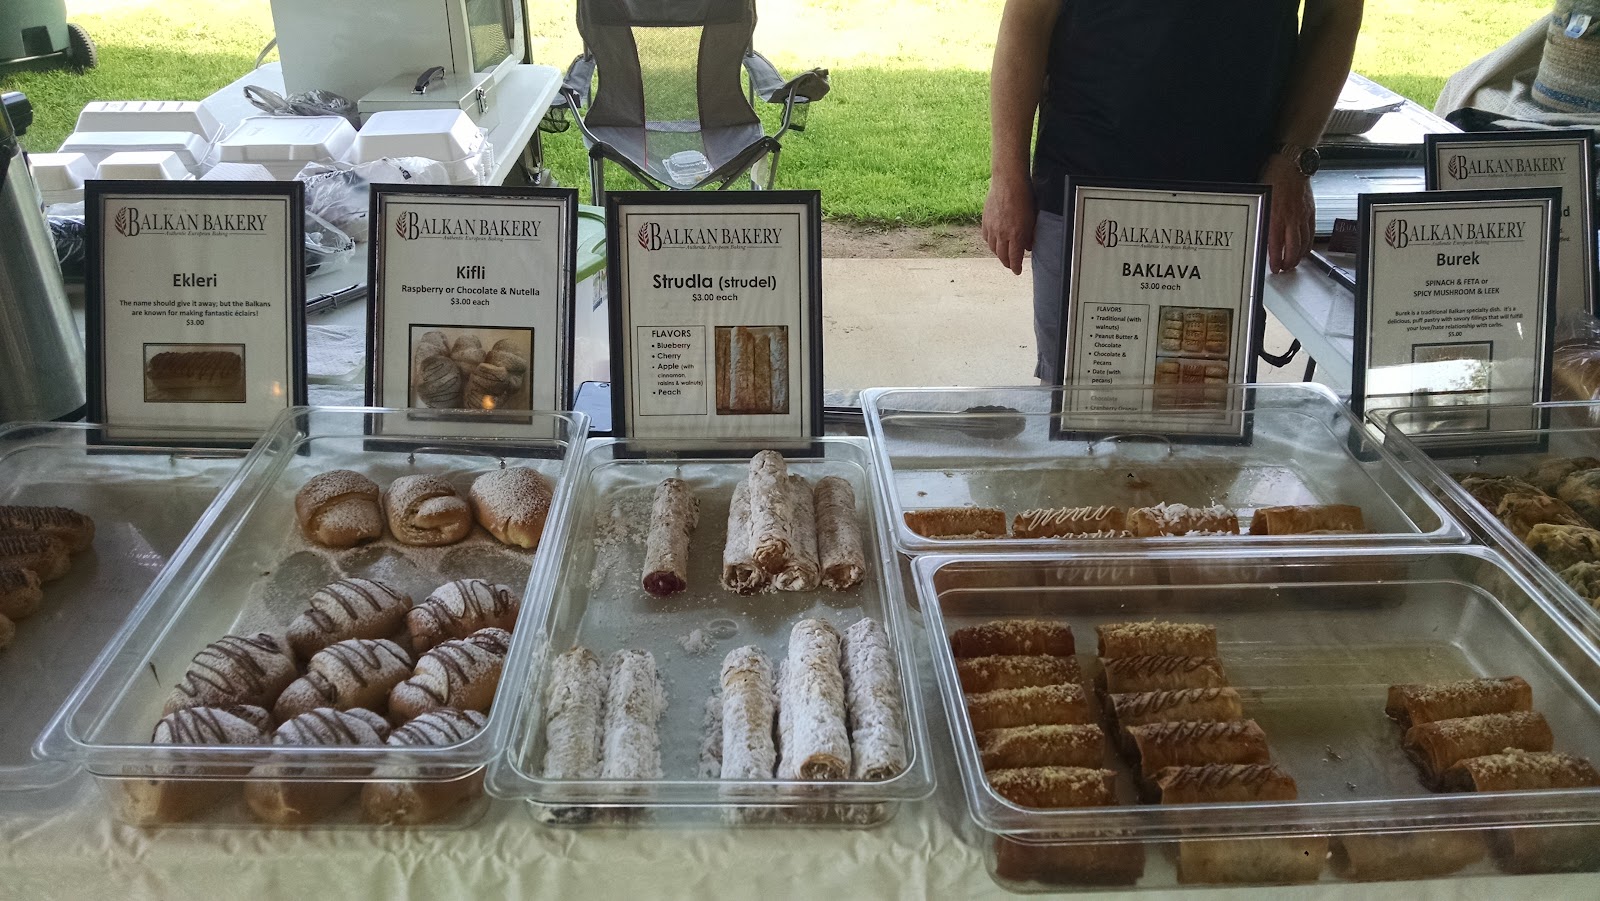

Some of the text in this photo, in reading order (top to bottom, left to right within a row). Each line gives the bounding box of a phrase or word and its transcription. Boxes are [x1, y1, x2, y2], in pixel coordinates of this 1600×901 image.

[1458, 155, 1566, 180] BALKAN BAKERY
[128, 208, 268, 236] BALKAN BAKERY
[408, 211, 542, 240] BALKAN BAKERY
[650, 222, 782, 250] BALKAN BAKERY
[1107, 220, 1234, 248] BALKAN BAKERY
[1396, 220, 1526, 248] BALKAN BAKERY
[1437, 251, 1480, 266] Burek
[456, 266, 486, 280] Kifli
[1122, 262, 1202, 280] BAKLAVA
[173, 273, 217, 287] Ekleri
[653, 274, 776, 290] Strudla (strudel)
[1140, 282, 1181, 291] $3.00 each
[1425, 278, 1455, 287] SPINACH
[402, 284, 444, 295] Raspberry
[456, 286, 498, 295] Chocolate
[510, 288, 540, 296] Nutella
[1413, 290, 1432, 298] SPICY
[1433, 288, 1476, 296] MUSHROOM
[1484, 287, 1500, 295] LEEK
[692, 294, 738, 302] $3.00 each
[652, 330, 692, 338] FLAVORS
